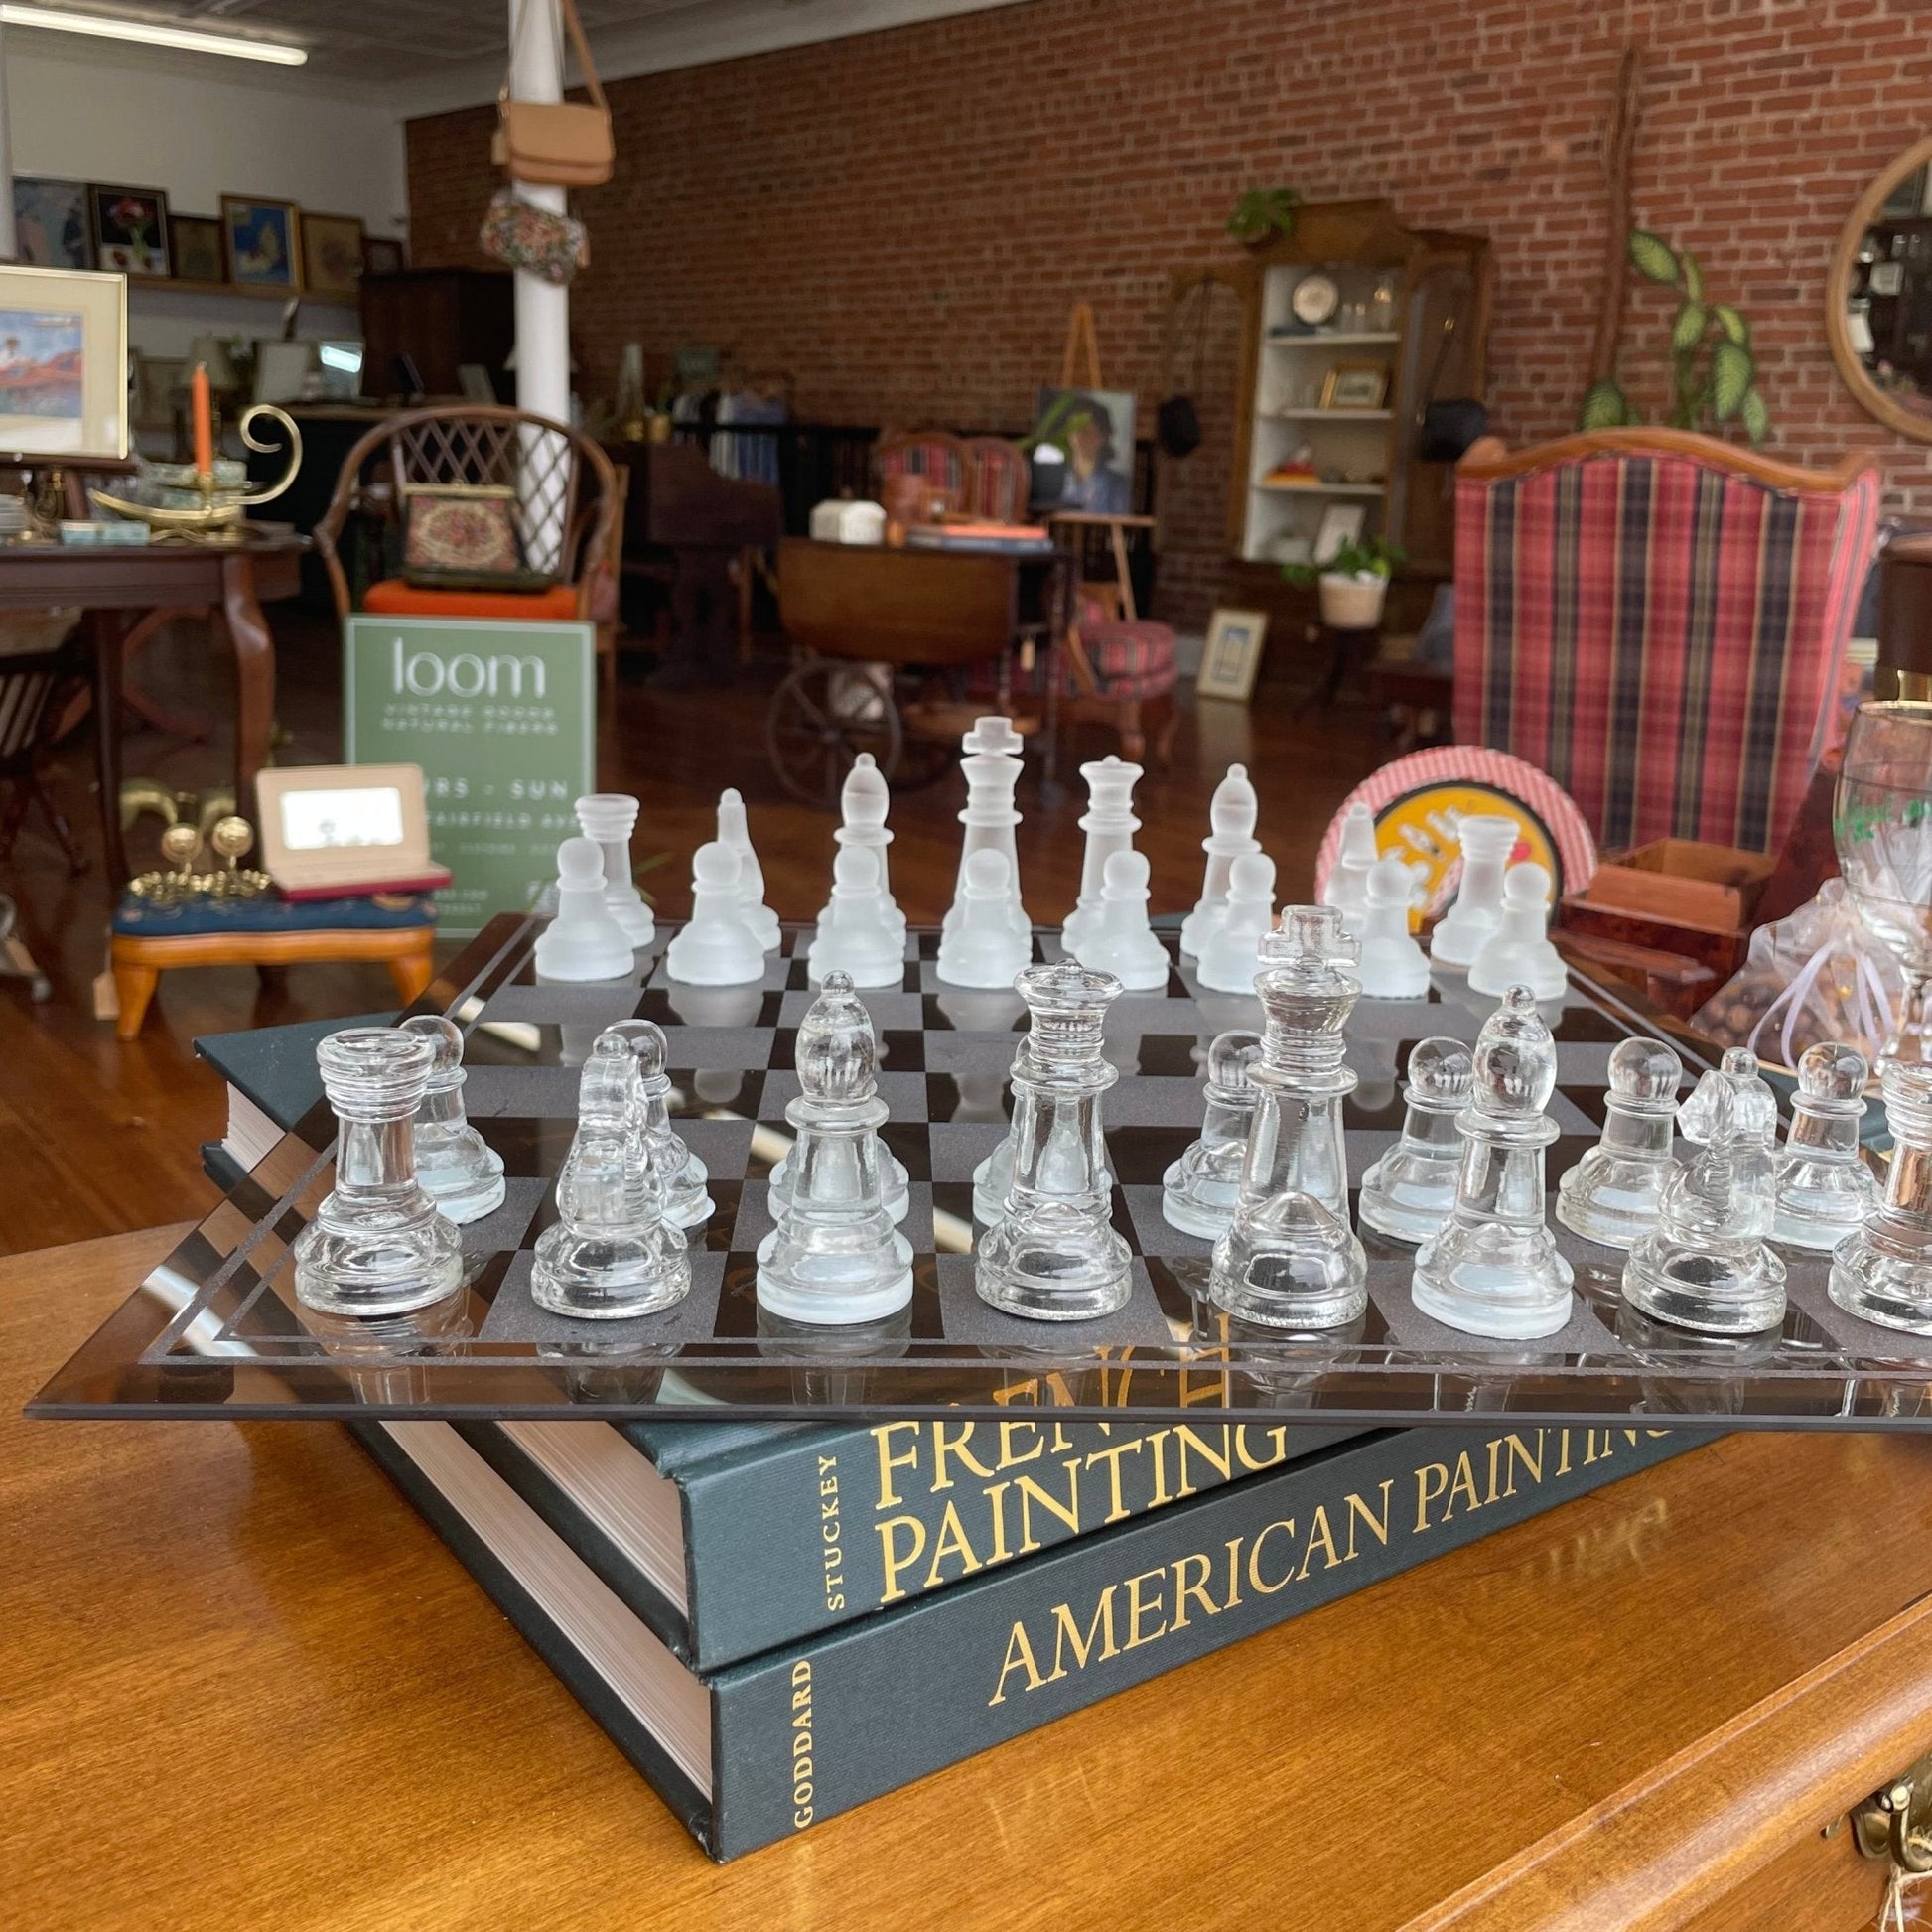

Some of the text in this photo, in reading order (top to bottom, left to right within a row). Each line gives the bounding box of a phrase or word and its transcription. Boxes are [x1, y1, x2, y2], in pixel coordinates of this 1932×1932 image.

[381, 717, 474, 734] NATURAL
[393, 636, 546, 699] loom
[508, 778, 569, 801] SUN
[818, 1454, 845, 1611] STUCKEY
[875, 1424, 1288, 1604] PAINTING
[988, 1478, 1395, 1707] AMERICAN
[791, 1659, 813, 1830] GODDARD
